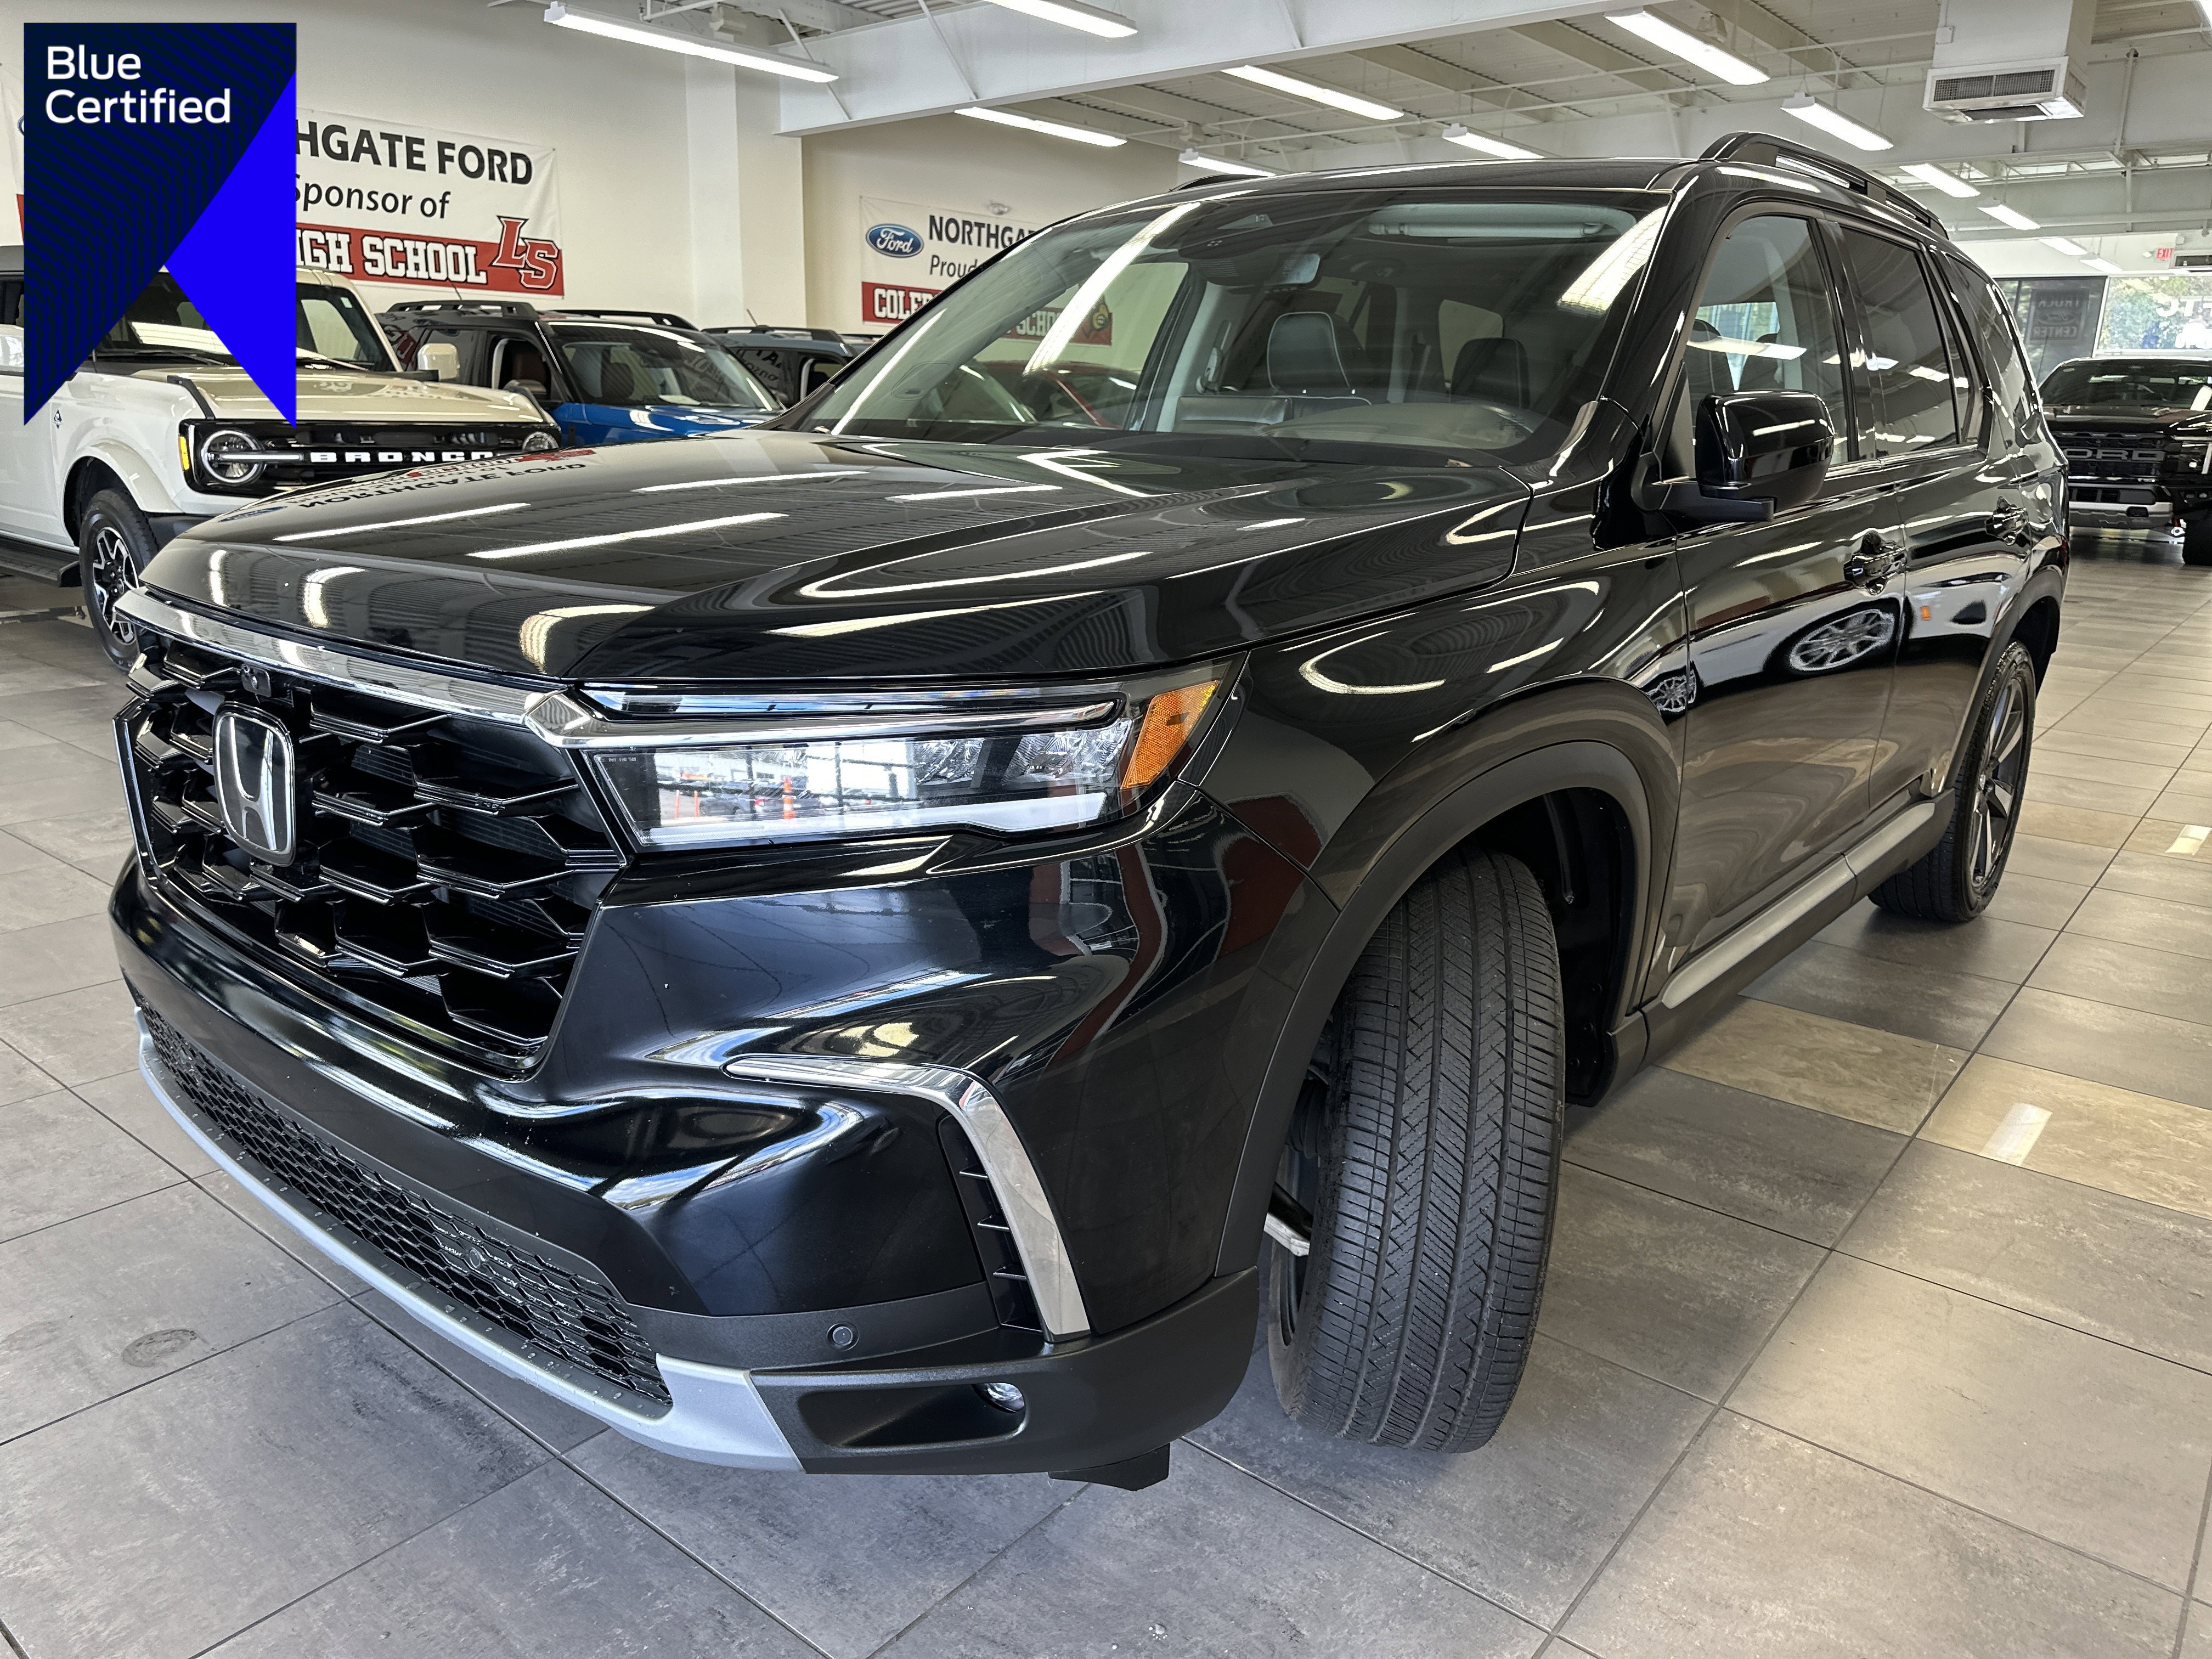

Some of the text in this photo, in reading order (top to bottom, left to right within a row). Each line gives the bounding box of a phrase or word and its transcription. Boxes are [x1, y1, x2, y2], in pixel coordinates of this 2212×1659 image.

[437, 140, 533, 185] FORD
[420, 191, 452, 219] of
[875, 227, 915, 253] Ford
[2157, 248, 2173, 259] EXIT
[362, 235, 488, 284] SCHOOL
[310, 452, 493, 462] BRONCO
